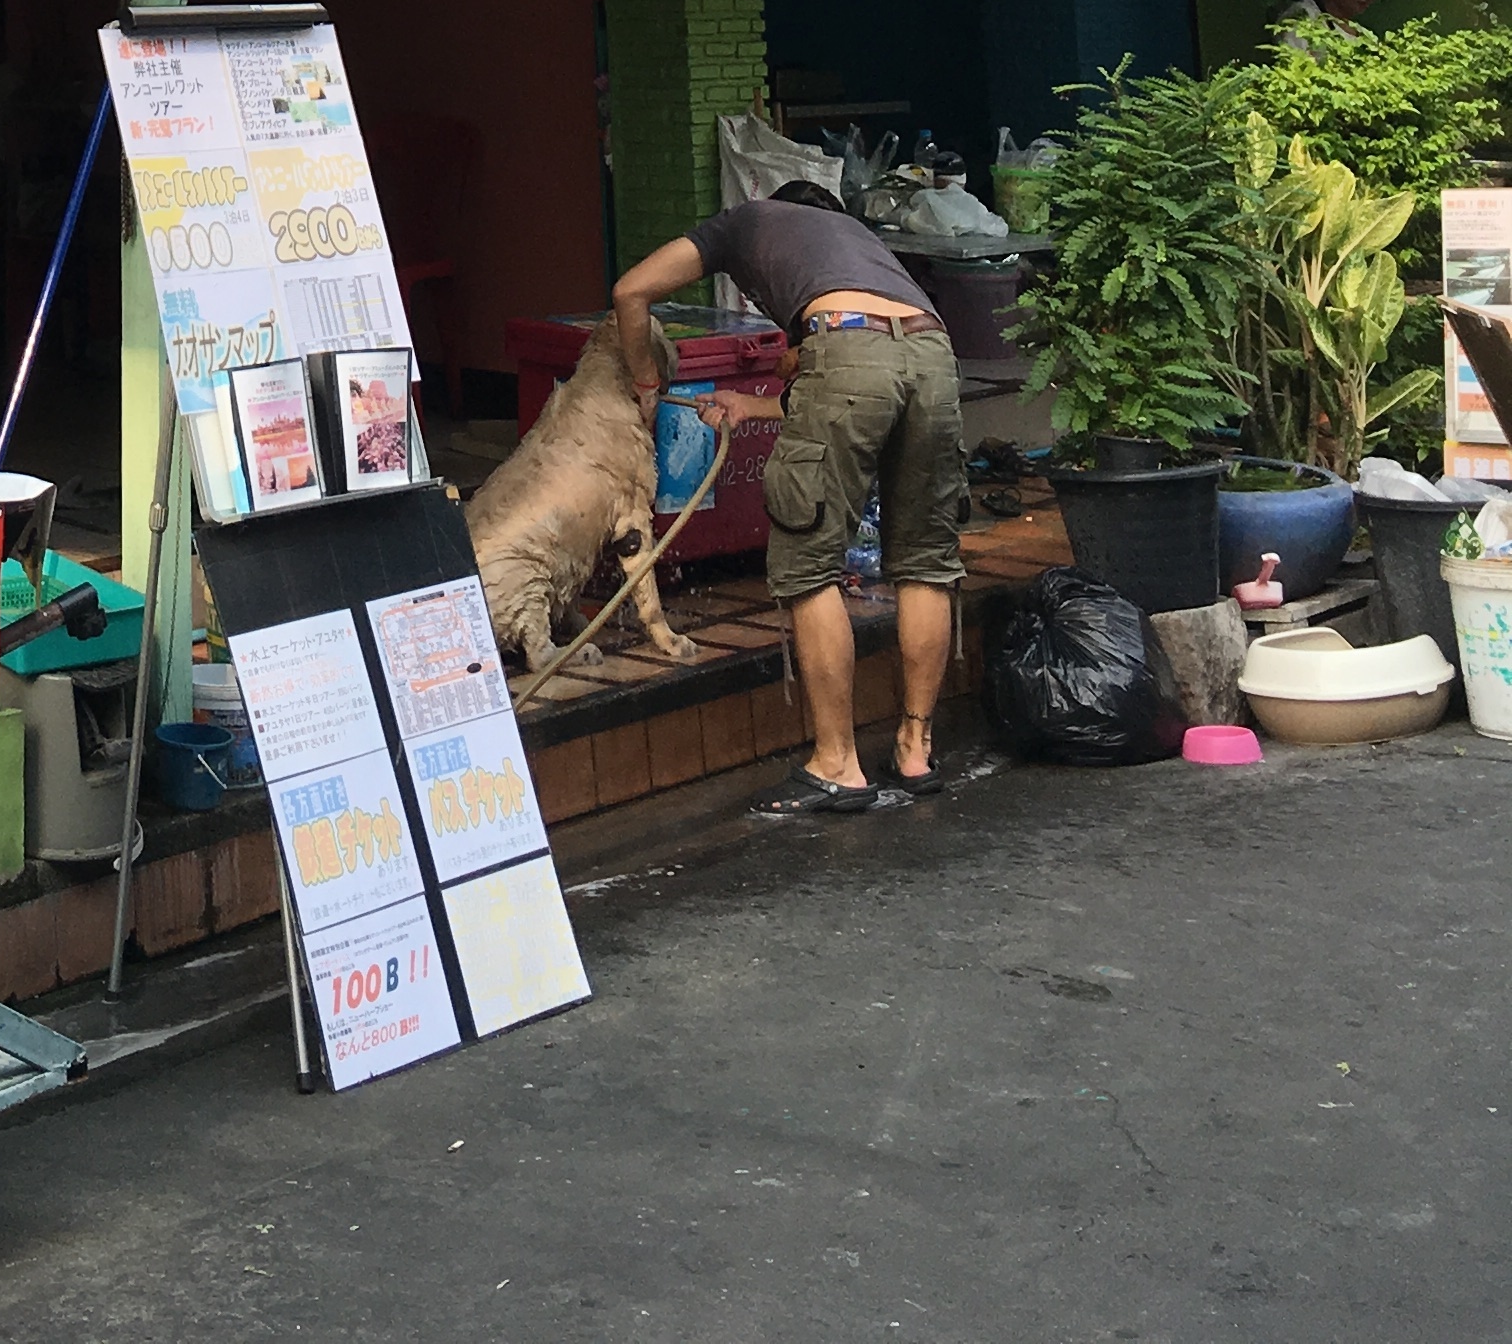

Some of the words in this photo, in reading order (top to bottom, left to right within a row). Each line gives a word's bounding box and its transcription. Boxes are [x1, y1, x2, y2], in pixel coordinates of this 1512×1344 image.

[120, 78, 204, 99] アンコールワット
[149, 100, 184, 117] ツアー
[268, 203, 359, 264] 2900
[332, 963, 383, 1017] 100
[386, 956, 399, 994] B
